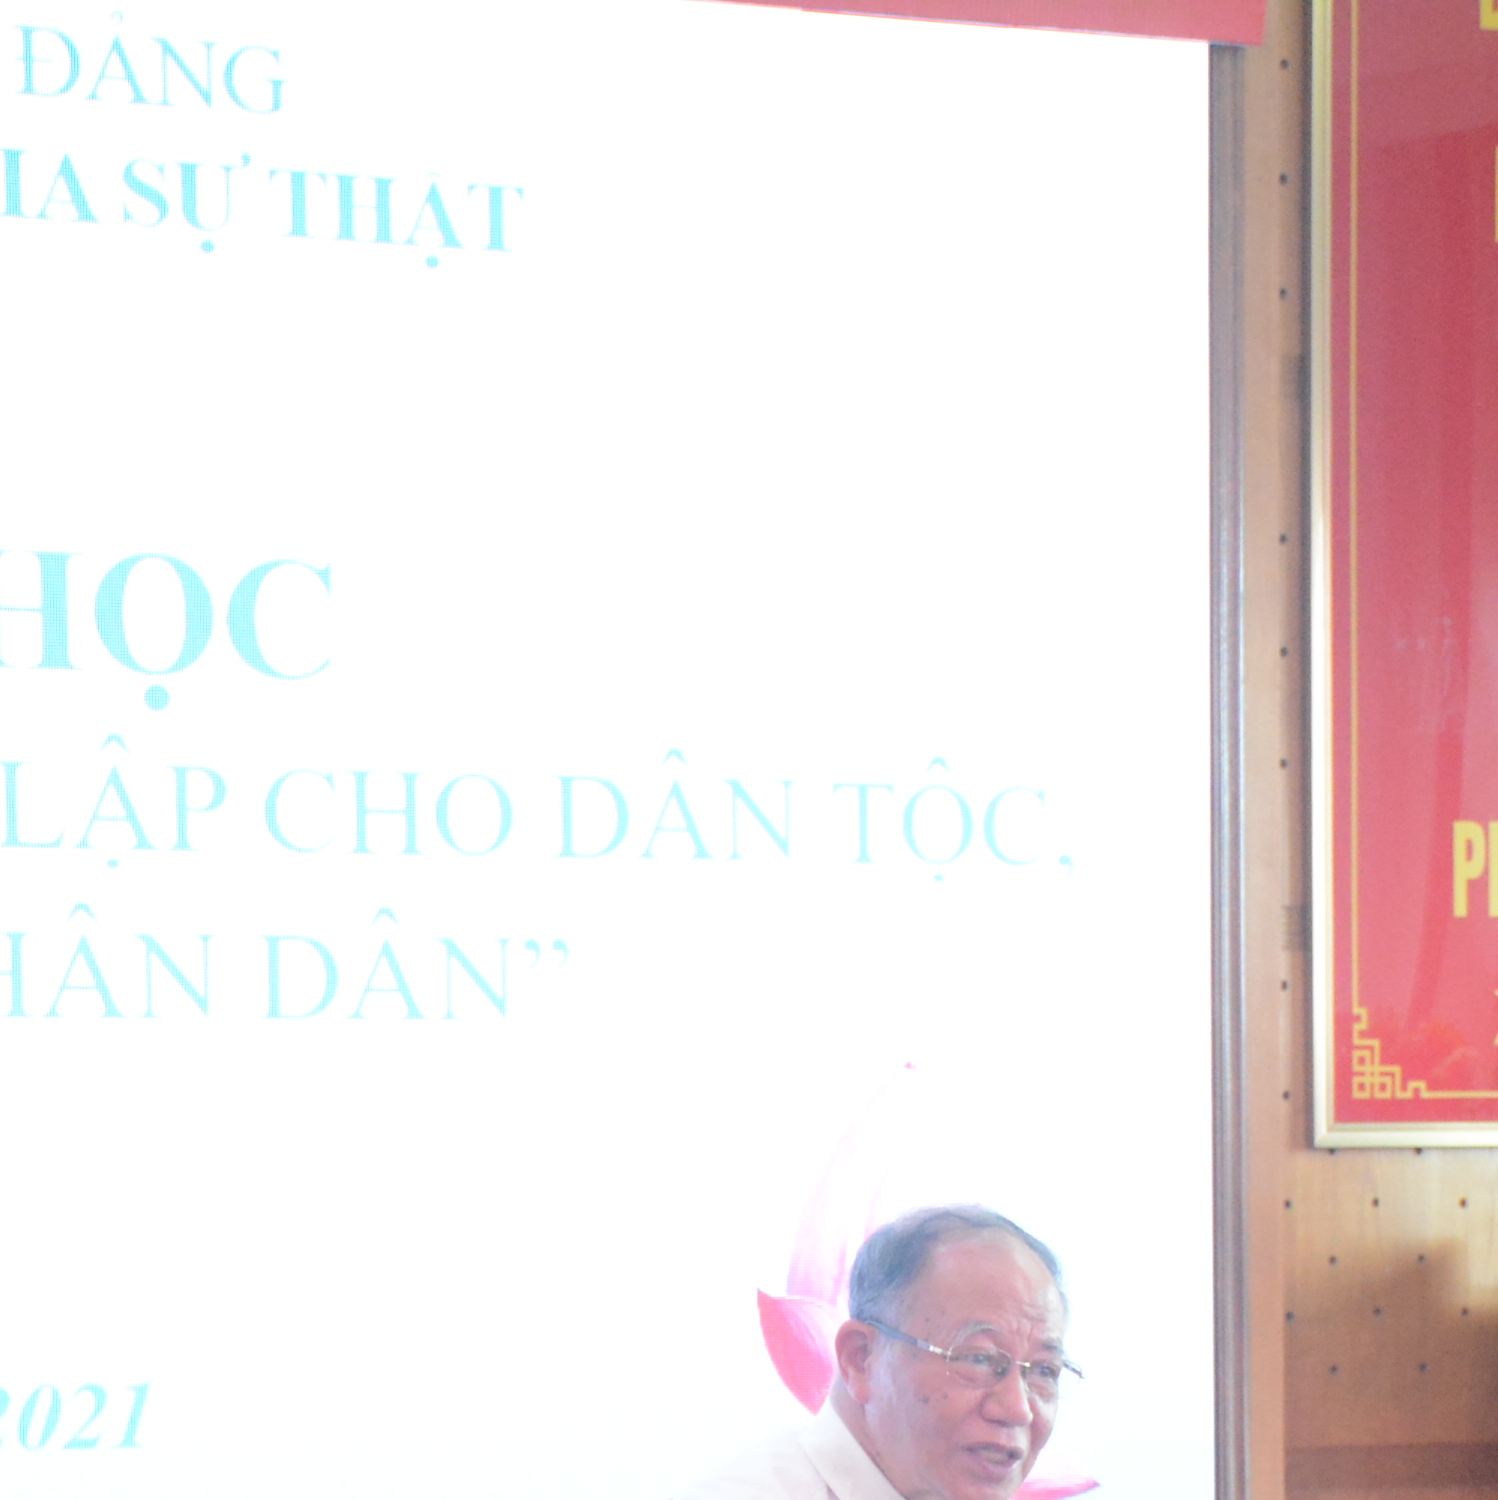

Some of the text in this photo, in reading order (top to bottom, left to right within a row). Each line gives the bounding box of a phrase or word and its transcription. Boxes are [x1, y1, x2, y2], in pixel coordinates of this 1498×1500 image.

[15, 8, 287, 114] ĐẢNG
[121, 150, 253, 254] SỰ
[268, 166, 525, 269] THẬT
[263, 769, 514, 857] CHO
[556, 747, 794, 861] DÂN
[832, 755, 1074, 883] TỘC,
